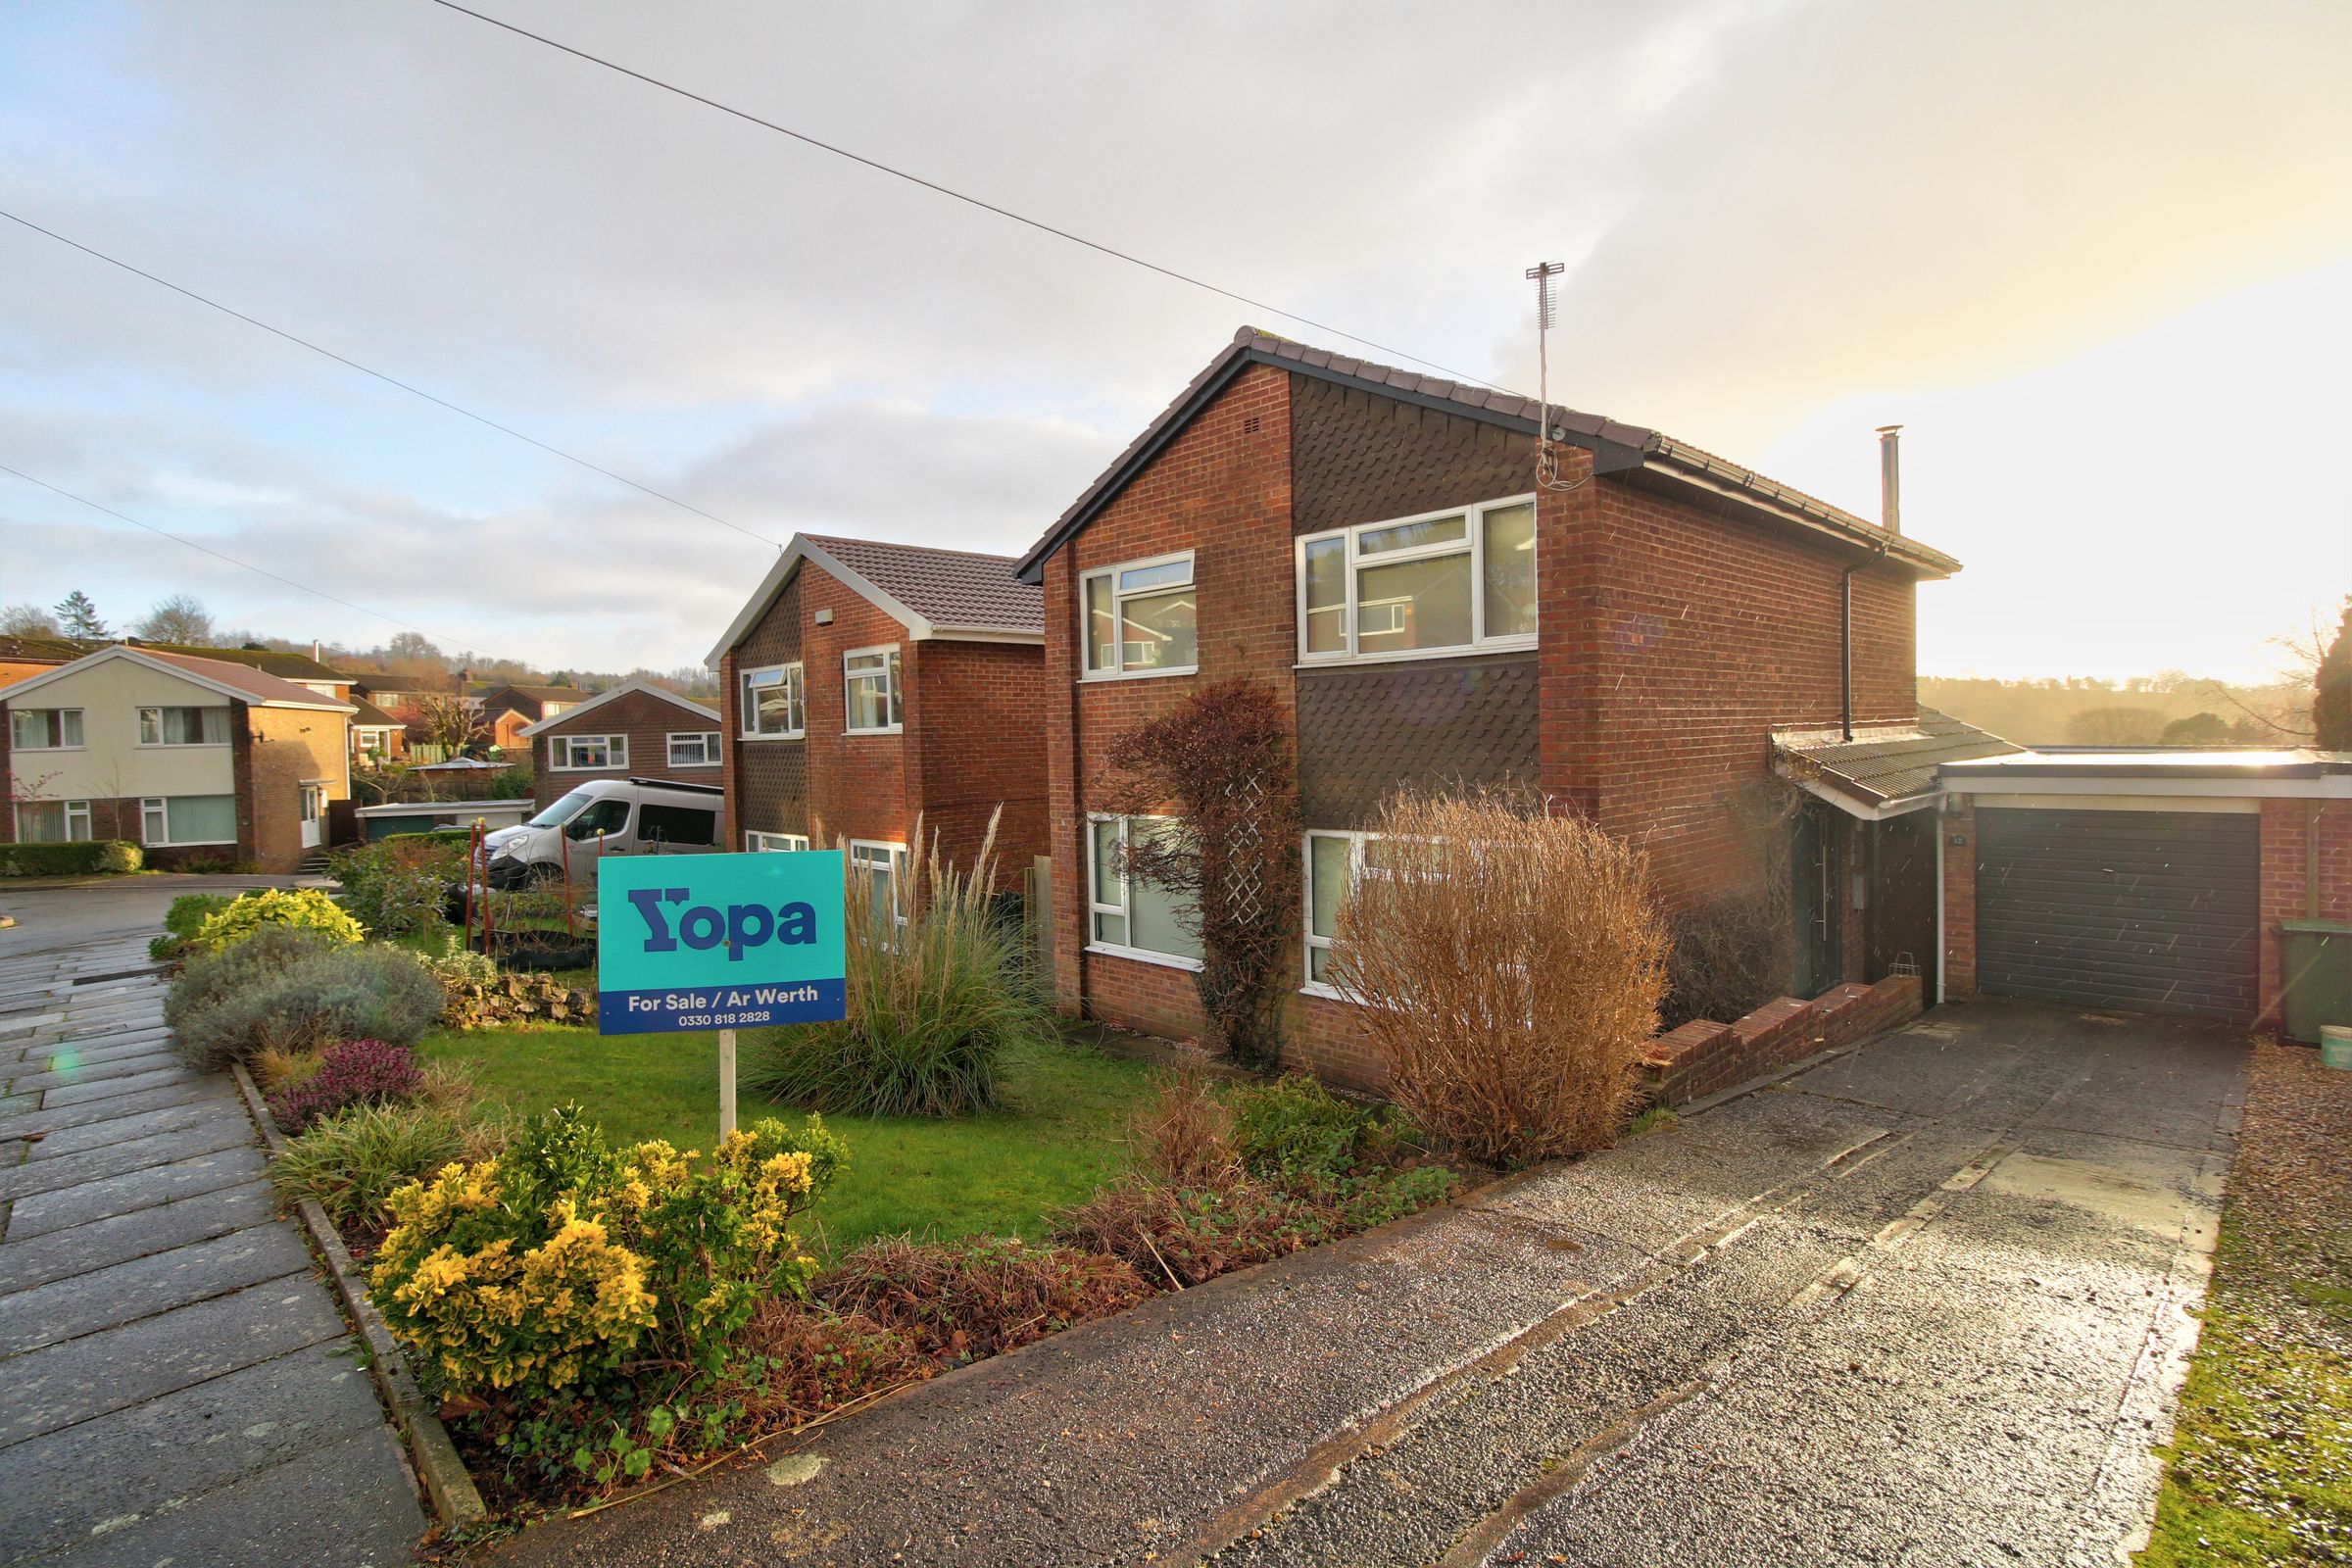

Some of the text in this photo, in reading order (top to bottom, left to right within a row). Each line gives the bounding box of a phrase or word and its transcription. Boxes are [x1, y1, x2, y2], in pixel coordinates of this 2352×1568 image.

[628, 887, 816, 961] Yopa
[628, 985, 818, 1012] For Sale / Ar Werth
[678, 1010, 770, 1027] 0330 818 2828
